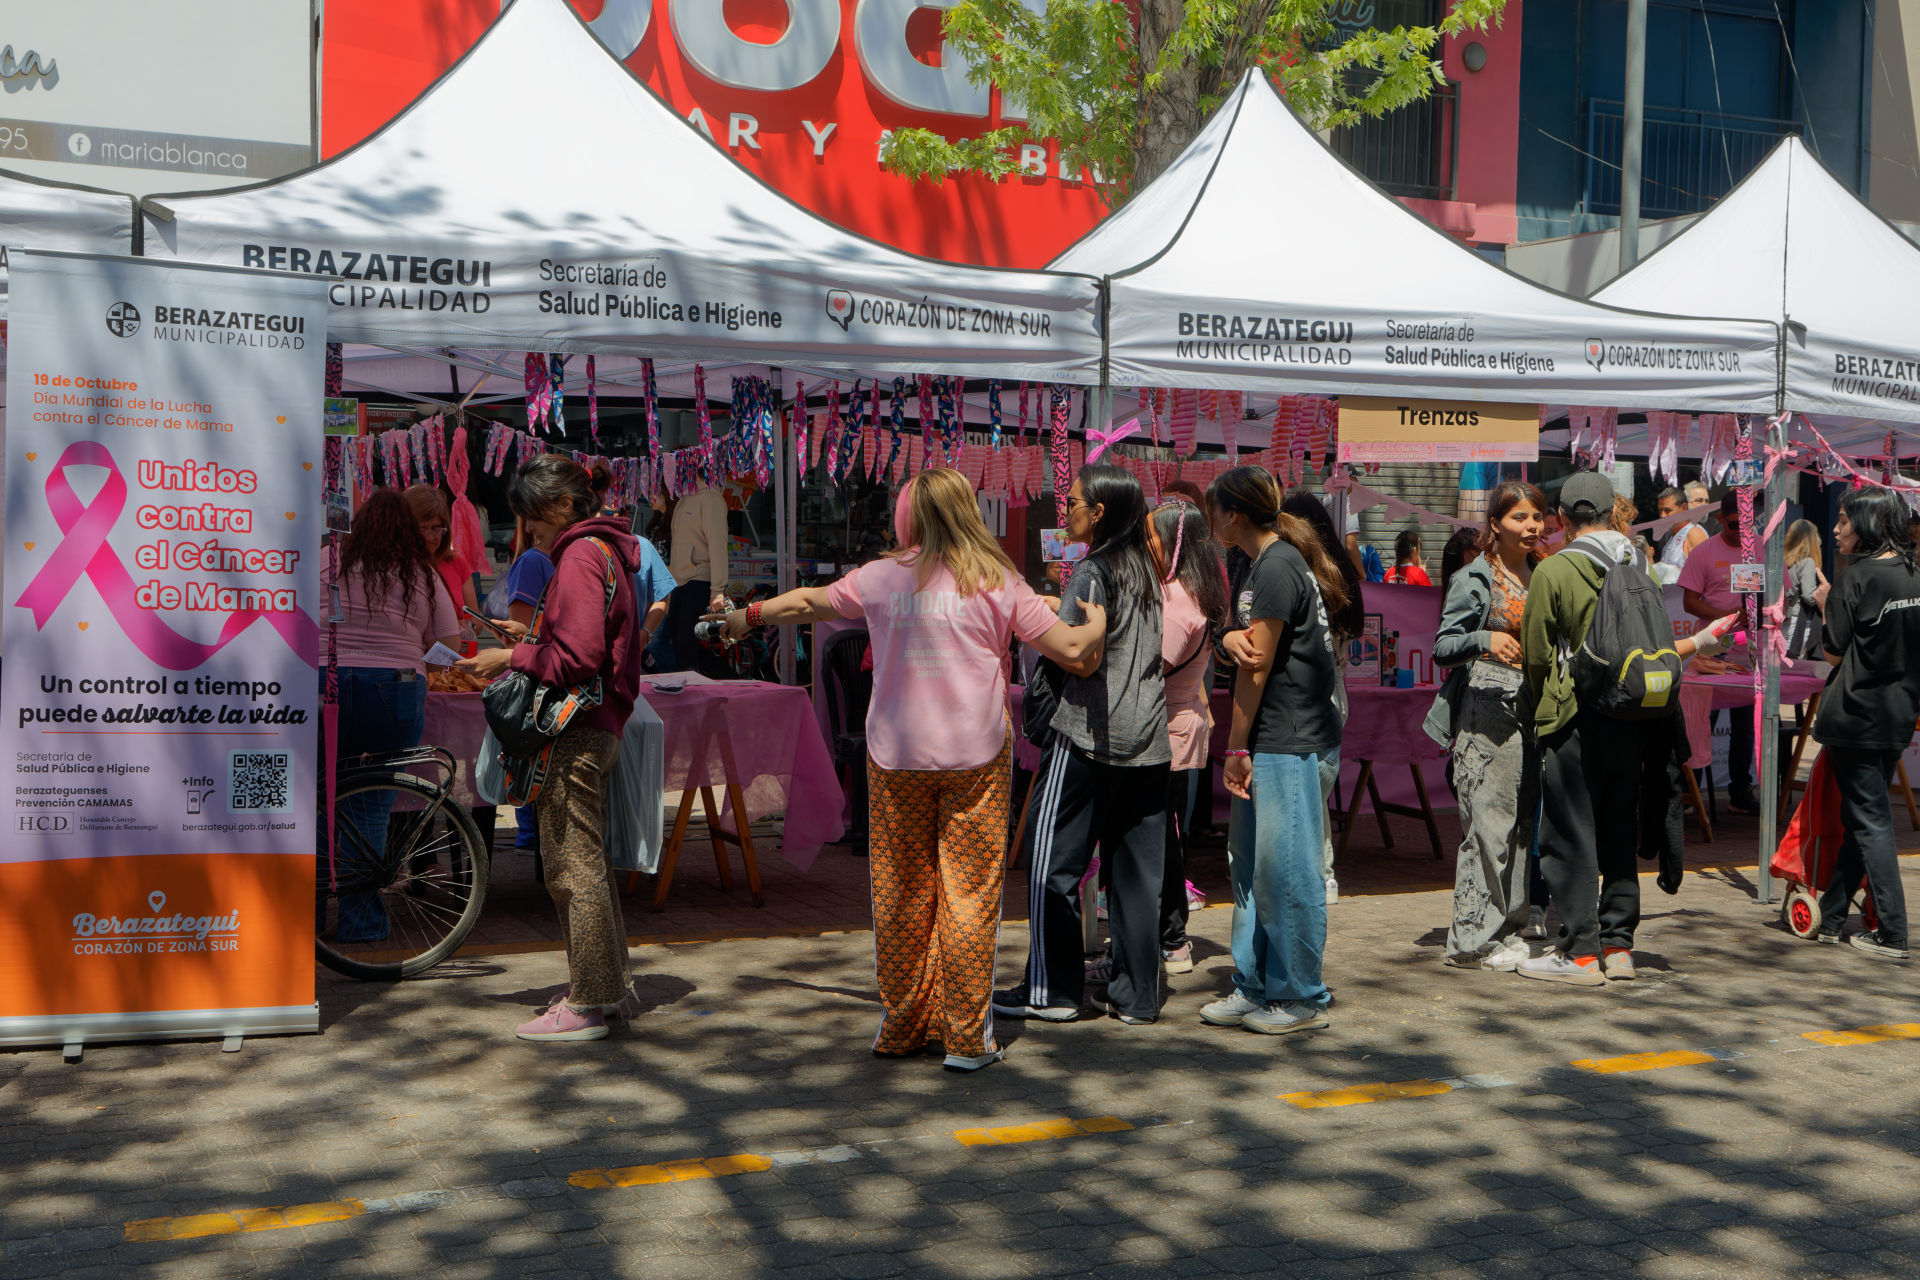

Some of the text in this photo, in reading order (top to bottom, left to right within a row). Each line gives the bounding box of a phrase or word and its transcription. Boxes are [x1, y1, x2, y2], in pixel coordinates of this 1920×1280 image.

[801, 120, 838, 155] Y
[101, 141, 248, 170] mariablanca
[243, 244, 491, 288] BERAZATEGUI
[539, 258, 667, 289] Secretaría de
[155, 305, 304, 334] BERAZATEGUI
[539, 289, 782, 331] Salud Pública e Higiene
[860, 295, 1051, 337] CORAZÓN DE ZONA SUR
[153, 326, 305, 350] MUNICIPALIDAD
[1178, 312, 1353, 344] BERAZATEGUI
[1386, 319, 1475, 343] Secretaría de
[1176, 340, 1352, 365] MUNICIPALIDAD
[1385, 345, 1555, 375] Salud Pública e Higiene
[1608, 339, 1742, 373] CORAZÓN DE ZONA SUR
[33, 373, 138, 391] 19 de Octubre
[33, 392, 212, 414] Día Mundial de la Lucha
[1397, 405, 1480, 426] Trenzas
[33, 412, 234, 433] contra el Cáncer de Mama
[138, 459, 257, 493] Unidos
[137, 503, 251, 533] contra
[136, 539, 299, 573] el Cáncer
[135, 580, 296, 613] de Mama
[40, 675, 281, 701] Un control a tiempo
[19, 704, 308, 728] puede salvarte la vida
[16, 751, 92, 762] Secretaría de
[16, 762, 150, 776] Salud Pública e Higiene
[15, 786, 108, 798] Berazateguenses
[182, 777, 214, 787] +Info
[15, 797, 133, 808] Prevención CAMAMAS
[19, 815, 70, 832] H.C.D.
[182, 822, 296, 833] berazategui.gob.ar/salud
[72, 909, 240, 940] Berazategui
[74, 939, 239, 955] CORAZÓN DE ZONA SUR
